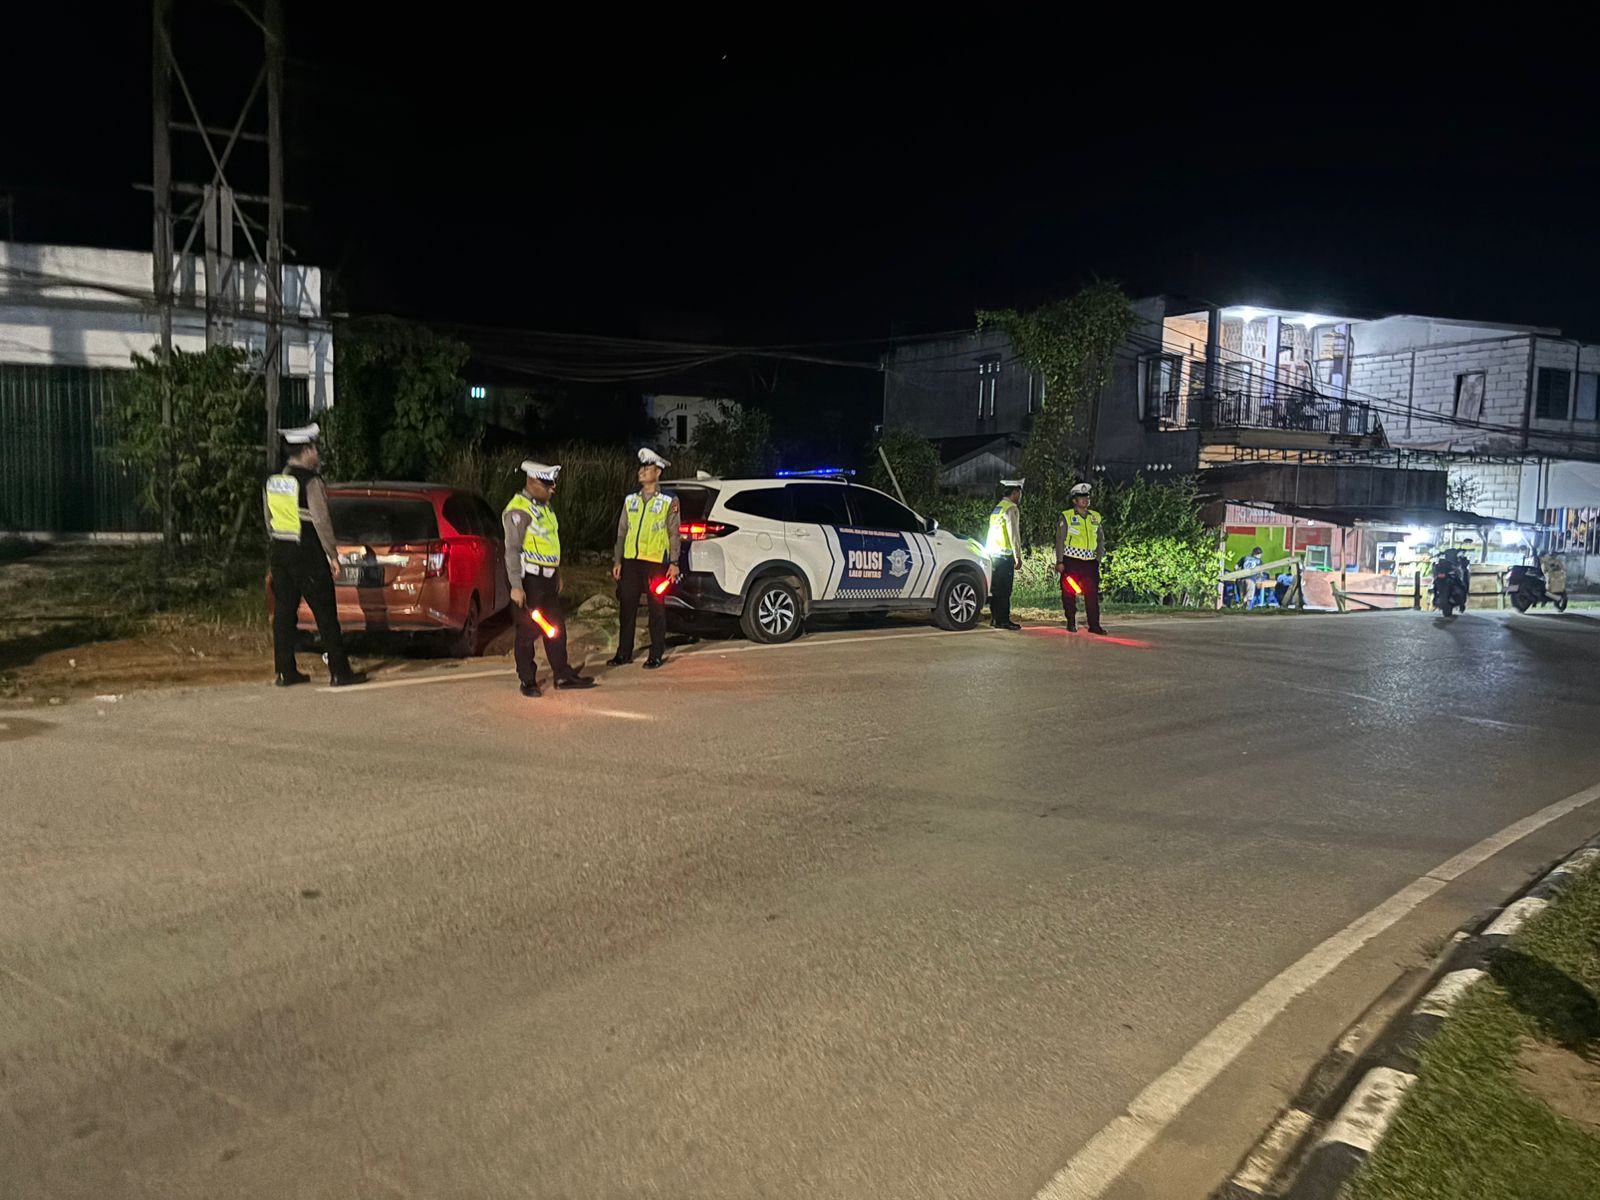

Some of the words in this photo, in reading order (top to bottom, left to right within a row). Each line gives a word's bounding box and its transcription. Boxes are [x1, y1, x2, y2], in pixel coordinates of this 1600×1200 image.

[848, 550, 883, 570] POLISI
[849, 569, 862, 578] LALU
[863, 570, 882, 579] LINTAS
